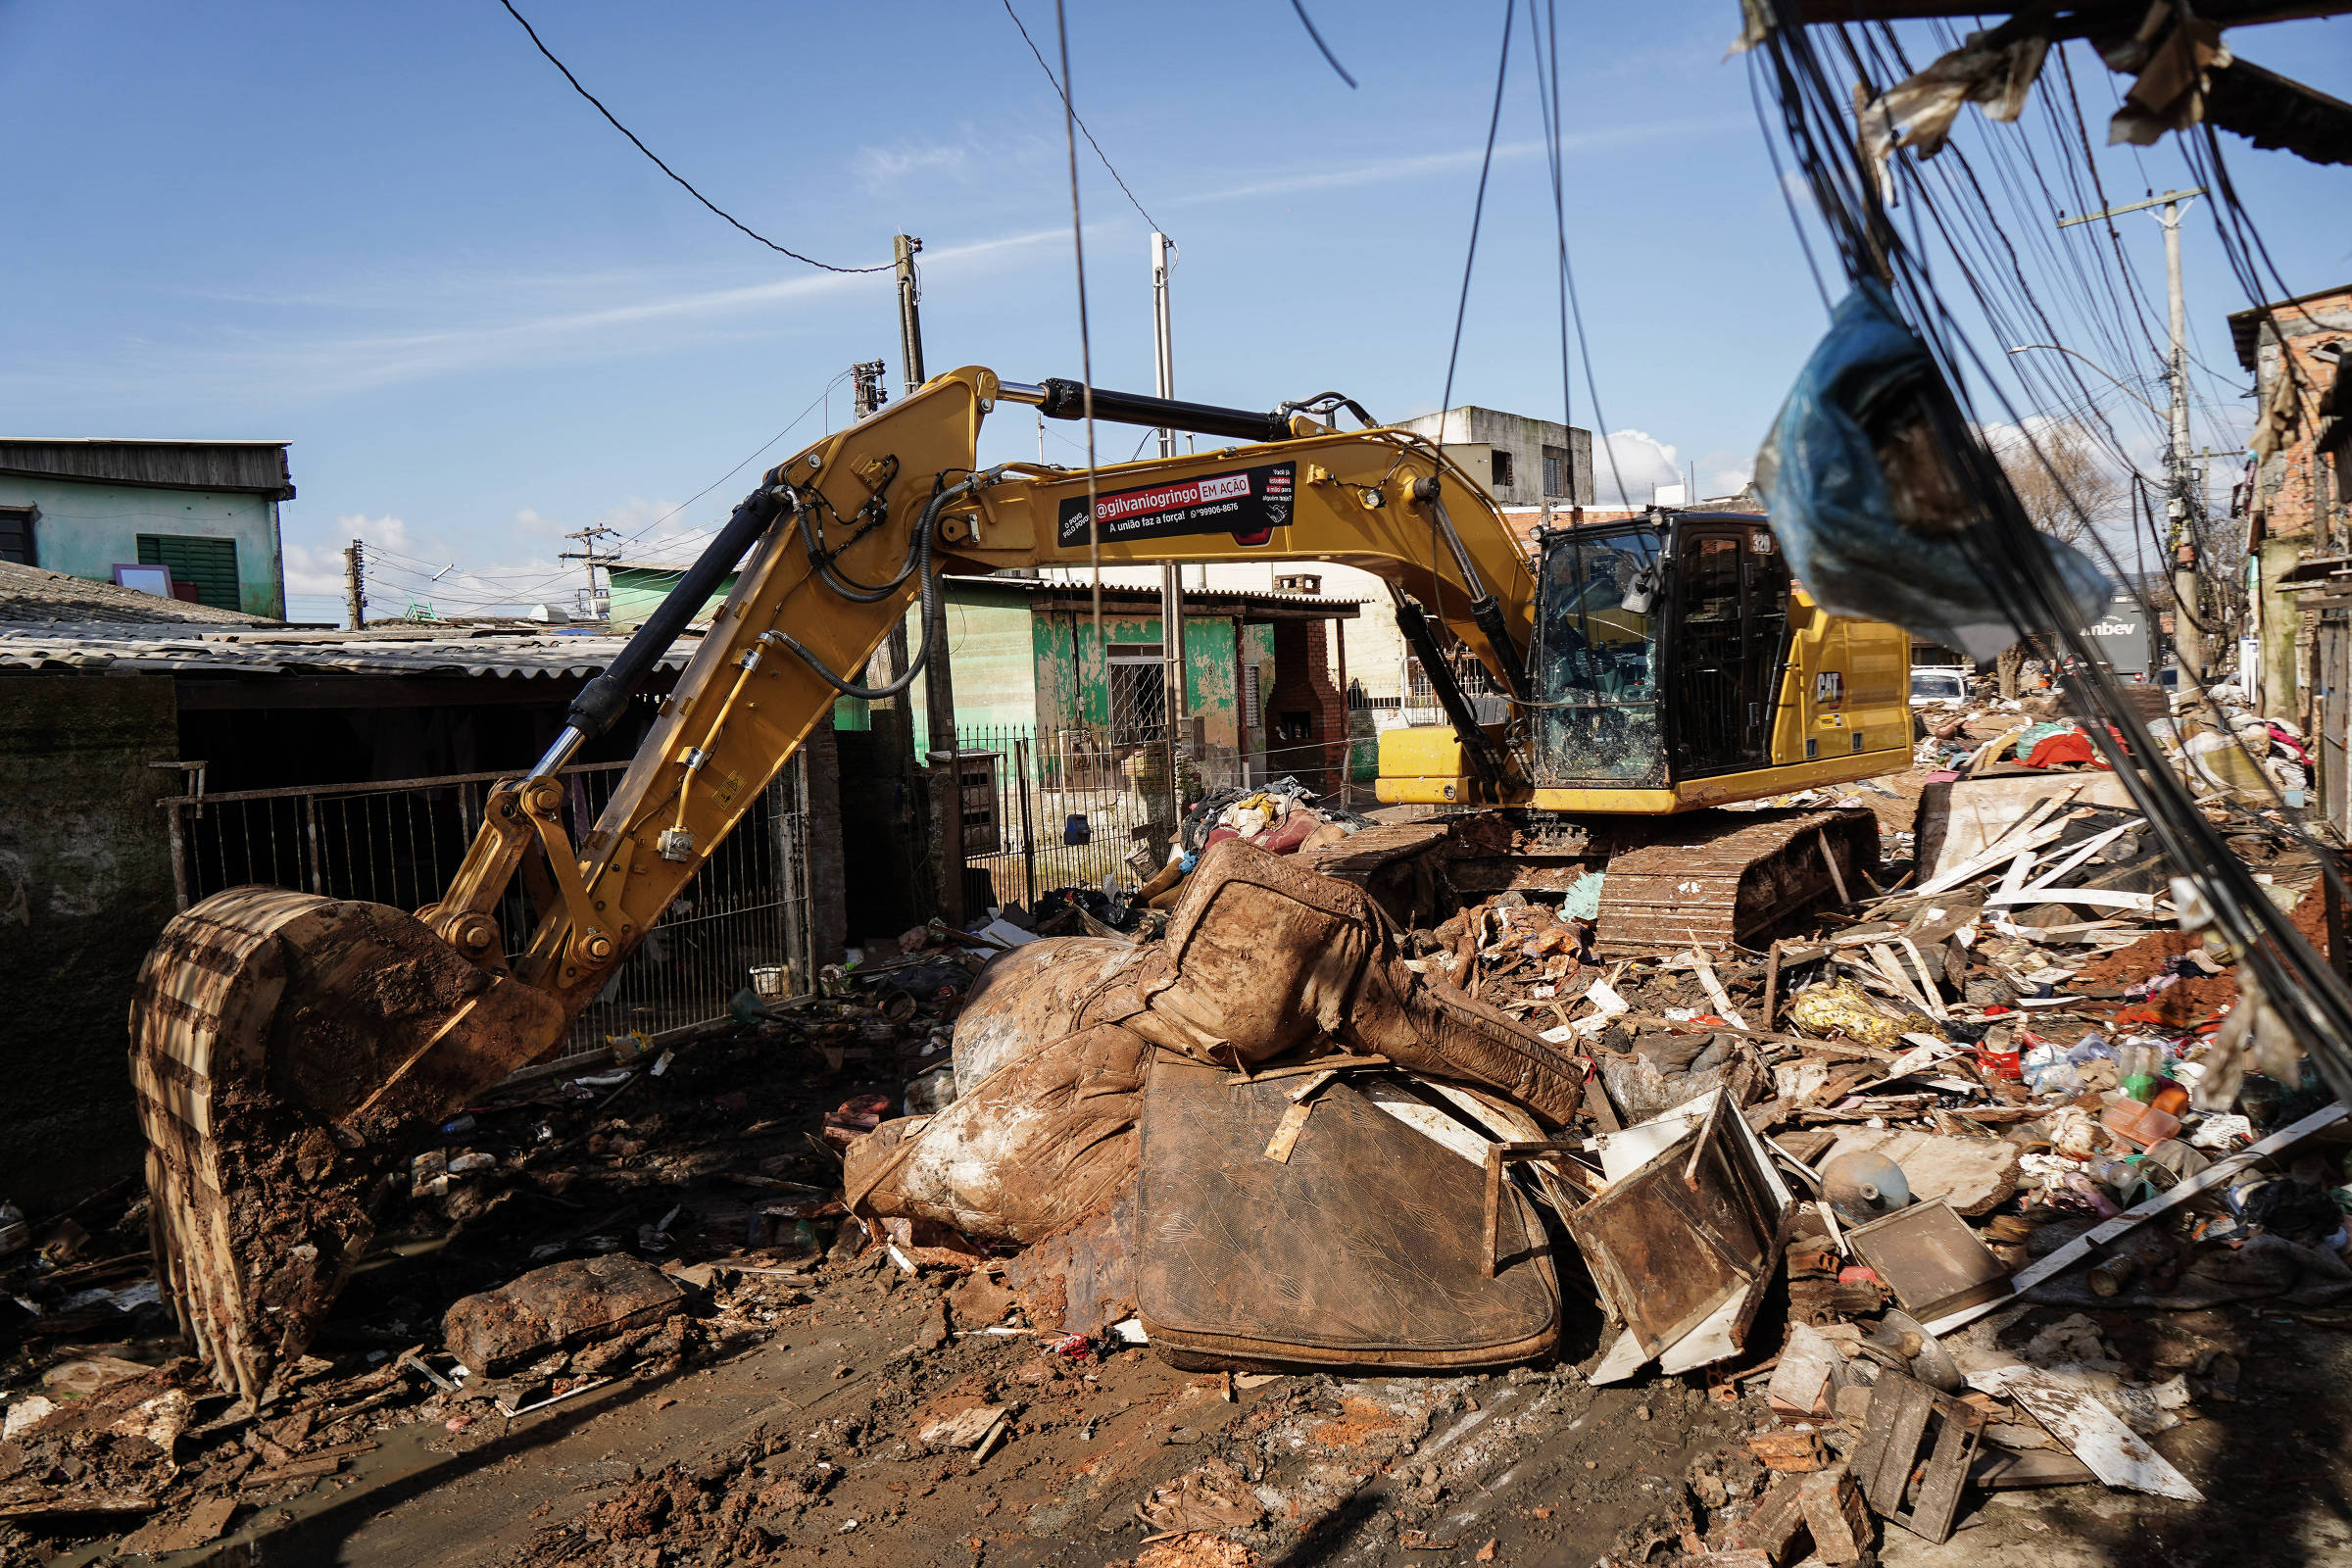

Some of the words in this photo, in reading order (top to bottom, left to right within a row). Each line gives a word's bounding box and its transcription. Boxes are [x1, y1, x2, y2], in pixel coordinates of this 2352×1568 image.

[1096, 489, 1198, 518] @gilvaniogringo
[1201, 484, 1217, 498] EM
[1220, 478, 1247, 496] AÇÃO
[1068, 512, 1083, 526] POVO
[1109, 522, 1116, 533] A
[1117, 519, 1141, 531] união
[1141, 516, 1154, 527] faz
[1162, 510, 1186, 523] força!
[1062, 525, 1076, 539] PELO
[1752, 534, 1771, 553] 320
[1817, 672, 1839, 702] CAT
